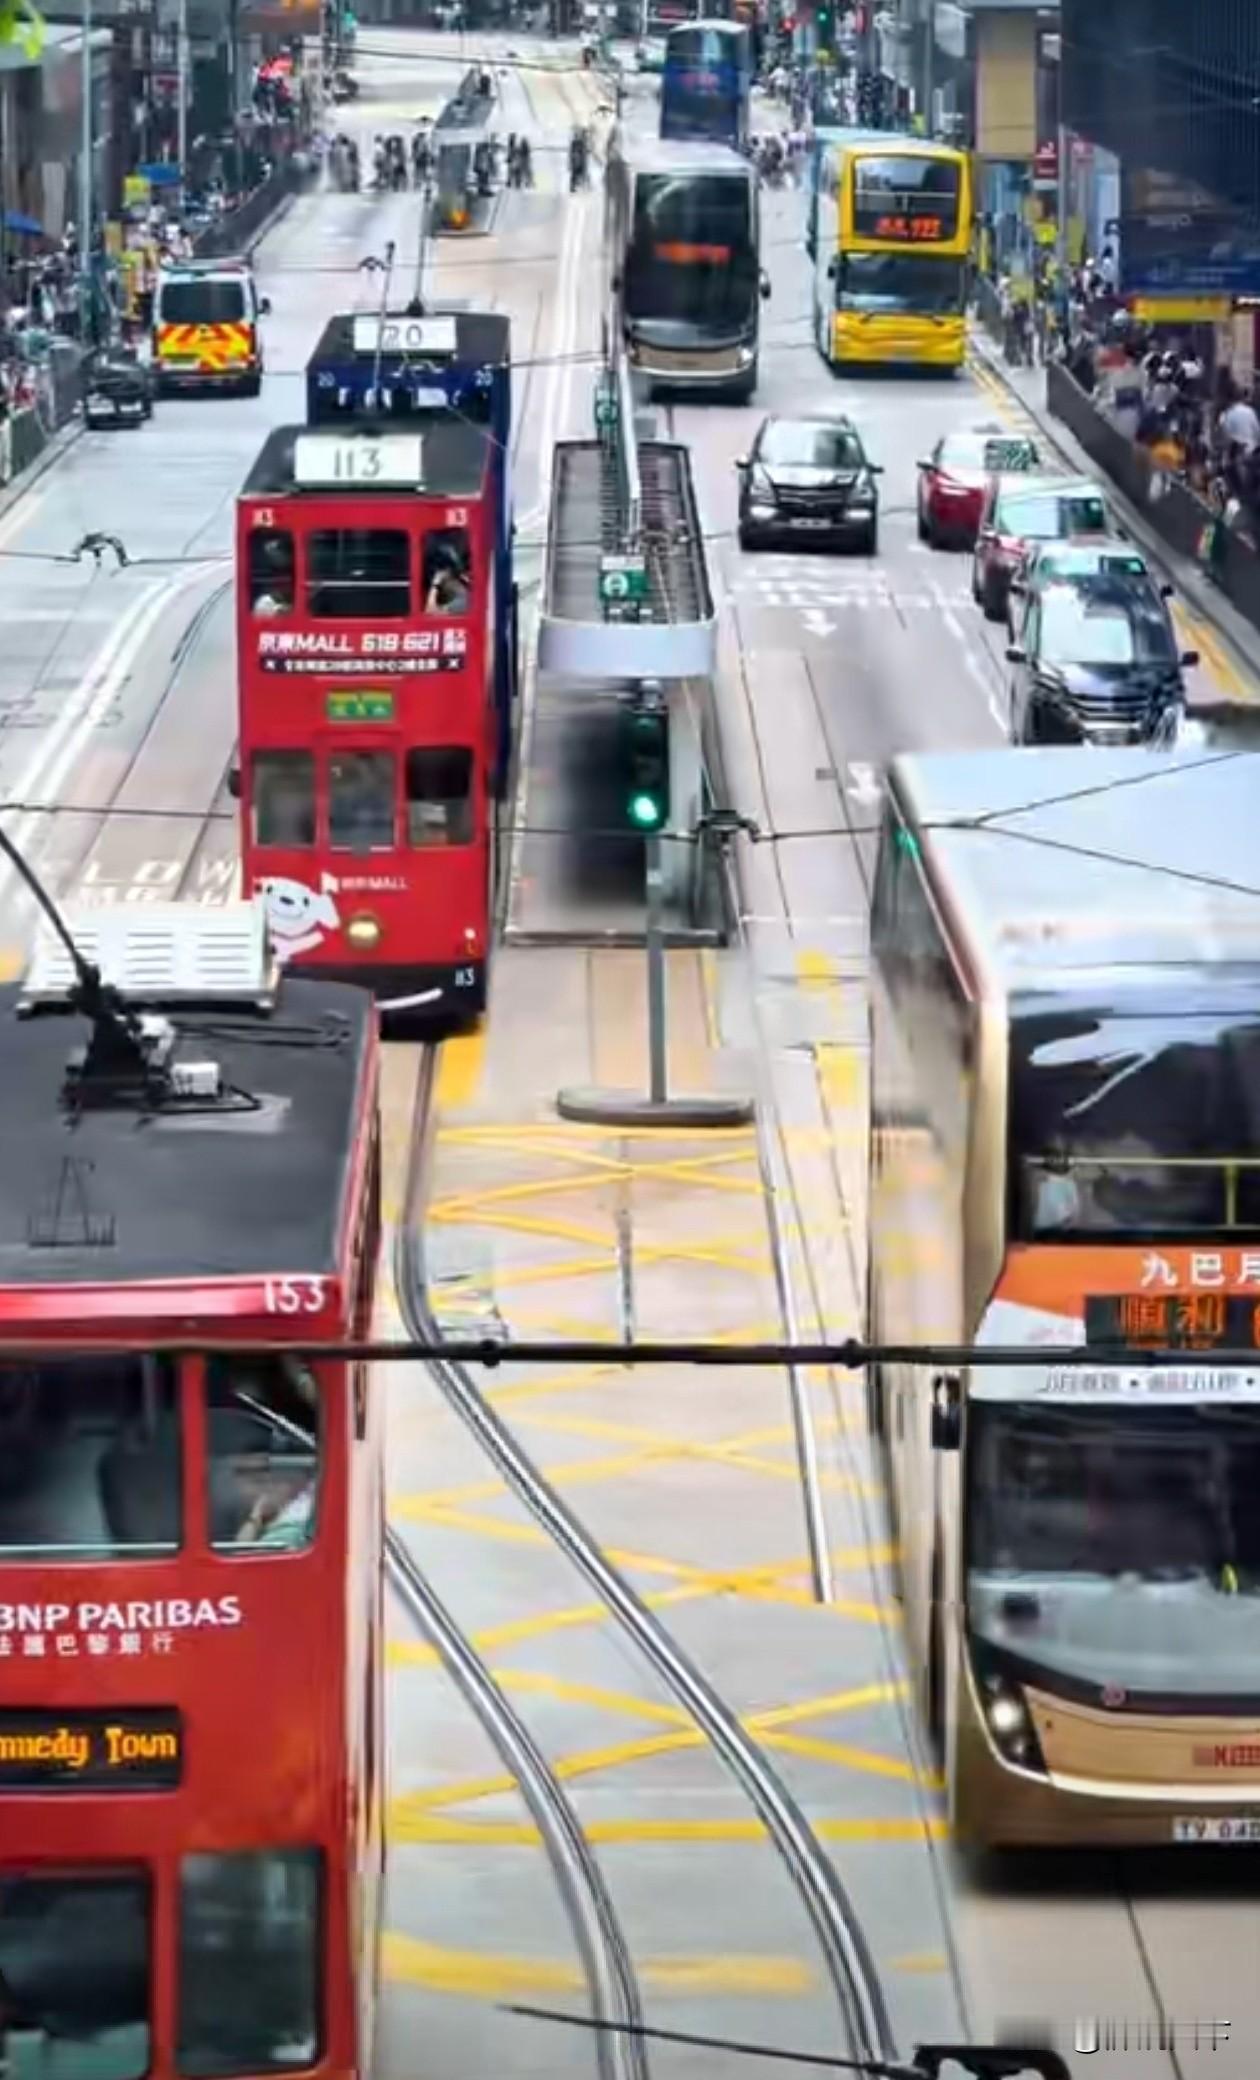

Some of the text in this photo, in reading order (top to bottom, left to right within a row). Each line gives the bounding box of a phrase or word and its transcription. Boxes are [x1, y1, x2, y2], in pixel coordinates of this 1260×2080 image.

[382, 325, 422, 346] 20
[474, 369, 494, 387] 20
[333, 447, 382, 478] 113
[454, 967, 476, 986] 113
[264, 1276, 324, 1312] 153
[0, 1596, 242, 1631] BNP PARIBAS
[105, 1727, 177, 1763] Town
